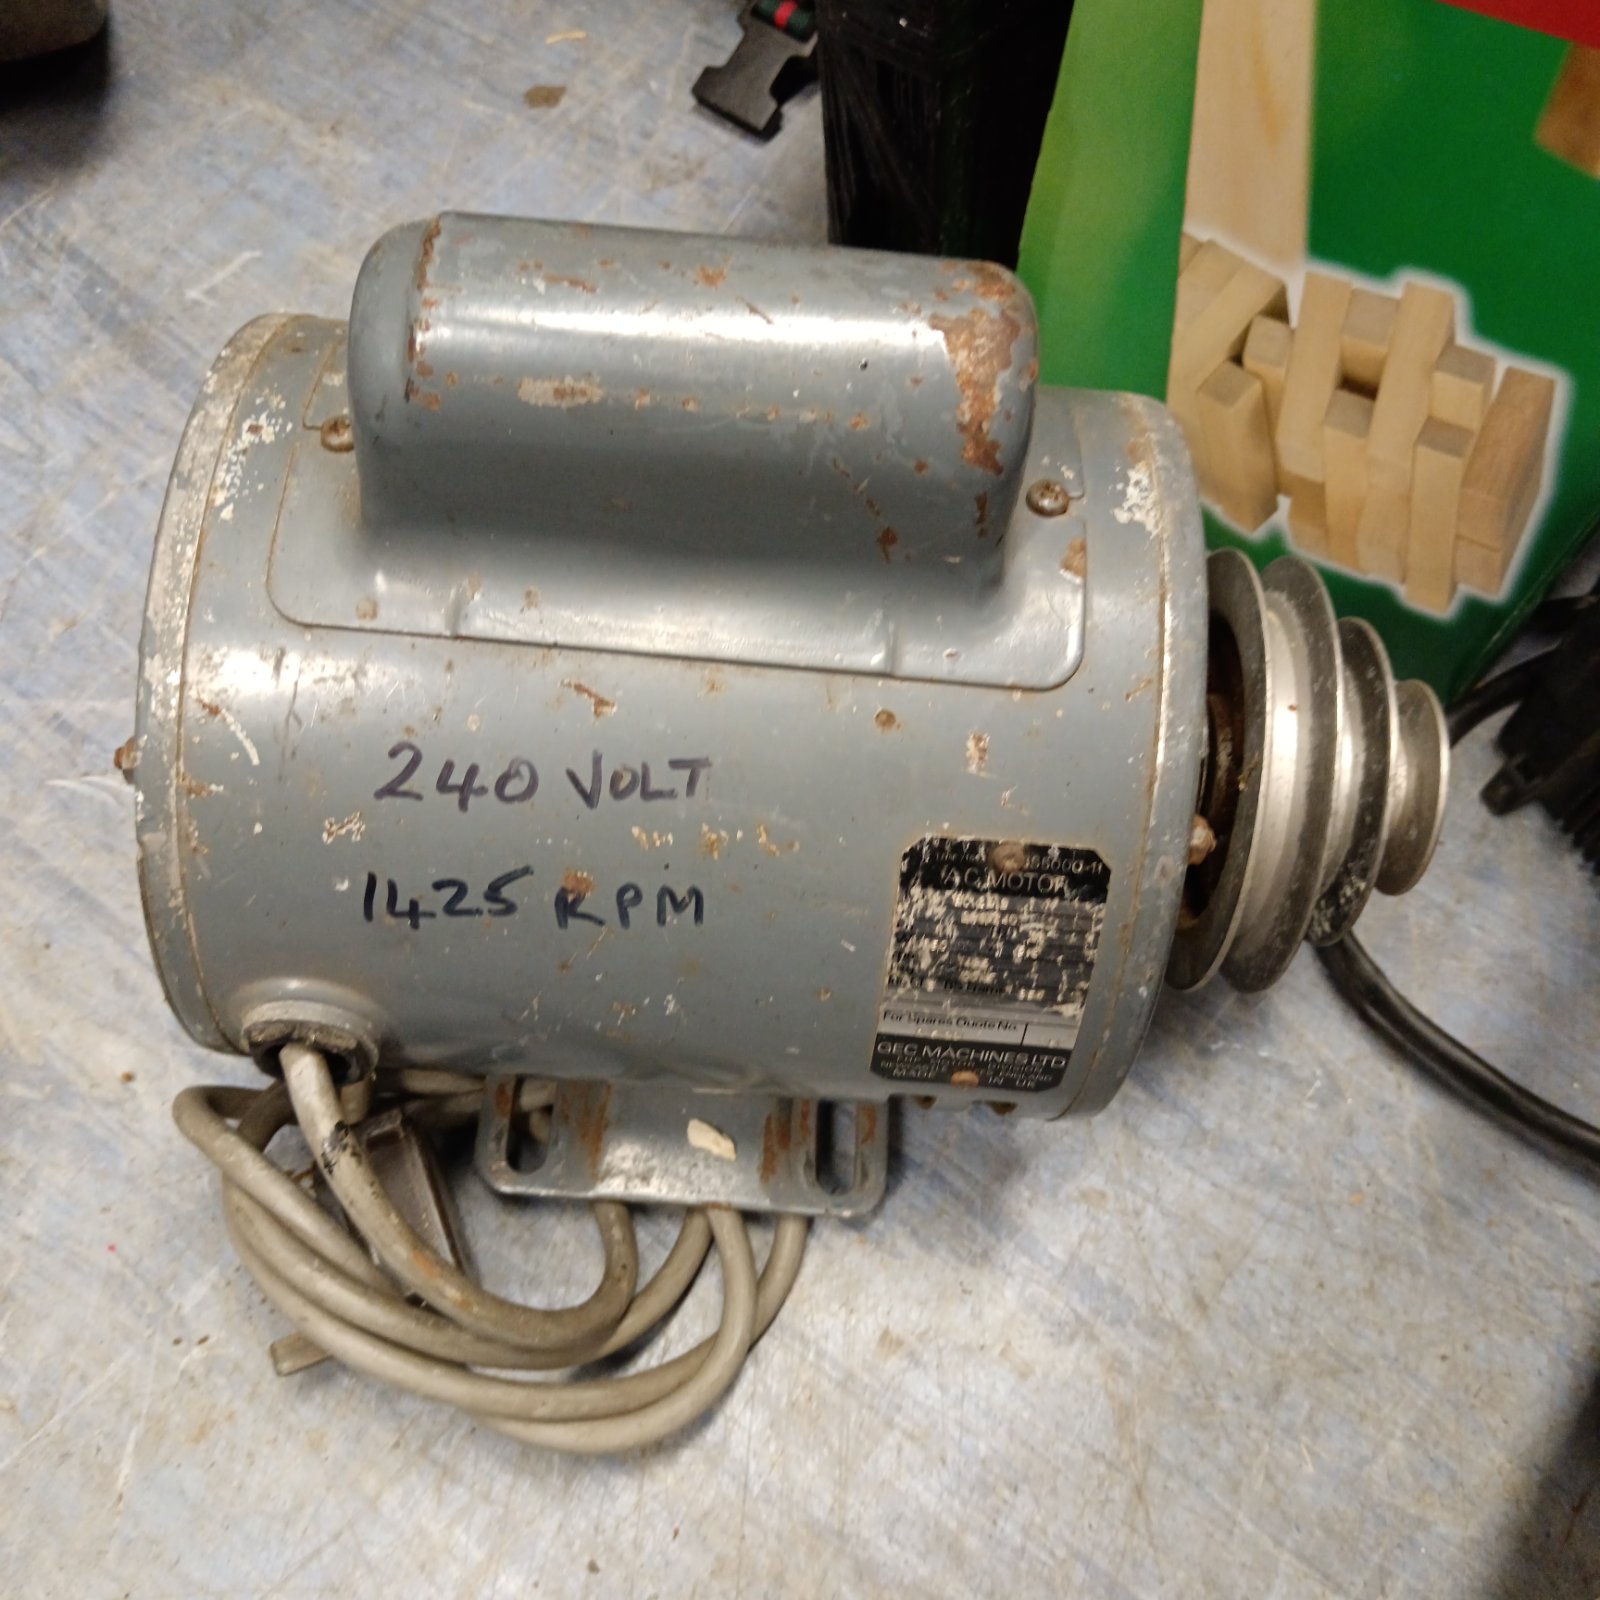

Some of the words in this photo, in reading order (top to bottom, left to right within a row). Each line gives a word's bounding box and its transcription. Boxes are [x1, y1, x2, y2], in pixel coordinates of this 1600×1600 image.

[373, 741, 539, 813] 240
[565, 750, 713, 810] VOLT
[363, 865, 534, 930] 1425
[554, 882, 704, 929] RPM
[882, 1010, 902, 1022] For
[907, 1013, 953, 1028] Spares
[955, 1017, 995, 1031] Quote
[876, 1041, 919, 1056] GEC
[921, 1044, 1030, 1066] MACHINES
[1030, 1054, 1067, 1070] LTD
[892, 1068, 938, 1080] MADE
